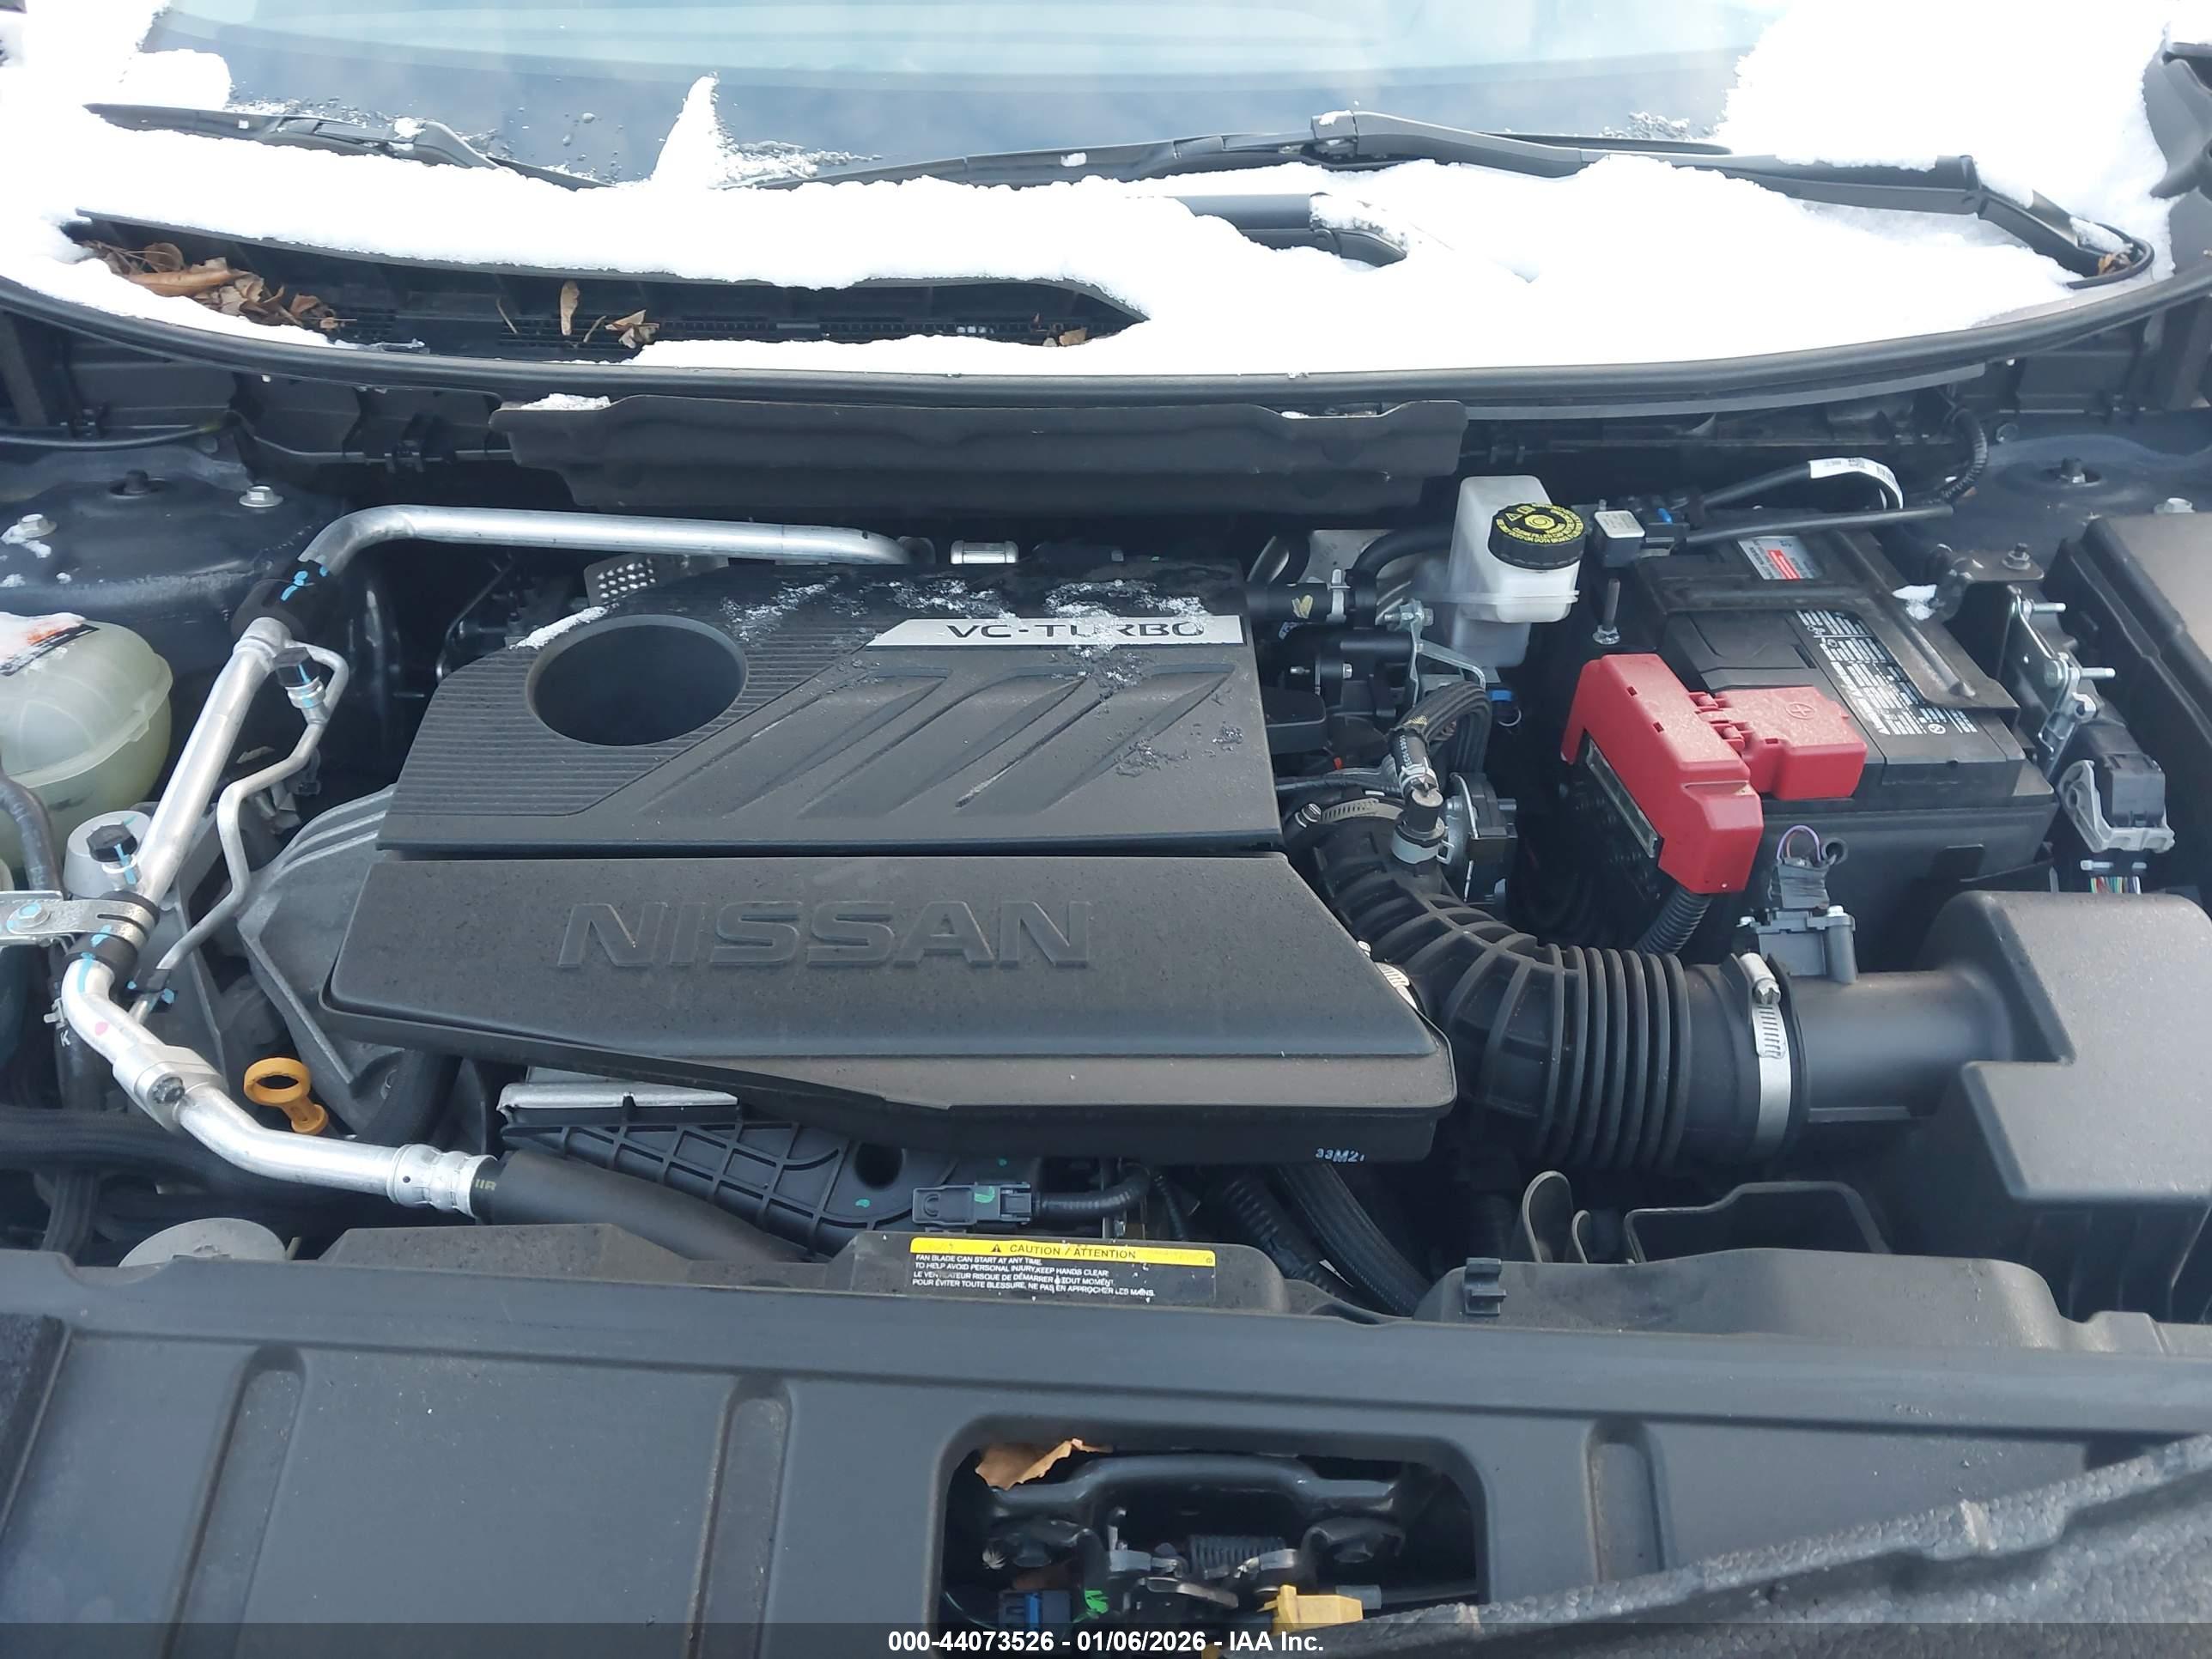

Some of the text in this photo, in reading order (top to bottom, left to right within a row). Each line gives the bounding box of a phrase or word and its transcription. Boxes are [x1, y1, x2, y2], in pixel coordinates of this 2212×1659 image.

[556, 901, 1092, 970] NISSAN
[1010, 1243, 1061, 1255] CAUTION
[1073, 1248, 1136, 1260] ATTENTION
[970, 1264, 1010, 1273] PERSONAL
[1056, 1267, 1082, 1276] HANDS
[935, 1278, 961, 1287] ÉVITER
[972, 1273, 1000, 1281] RISQUE
[1013, 1272, 1054, 1283] DÉMARRER
